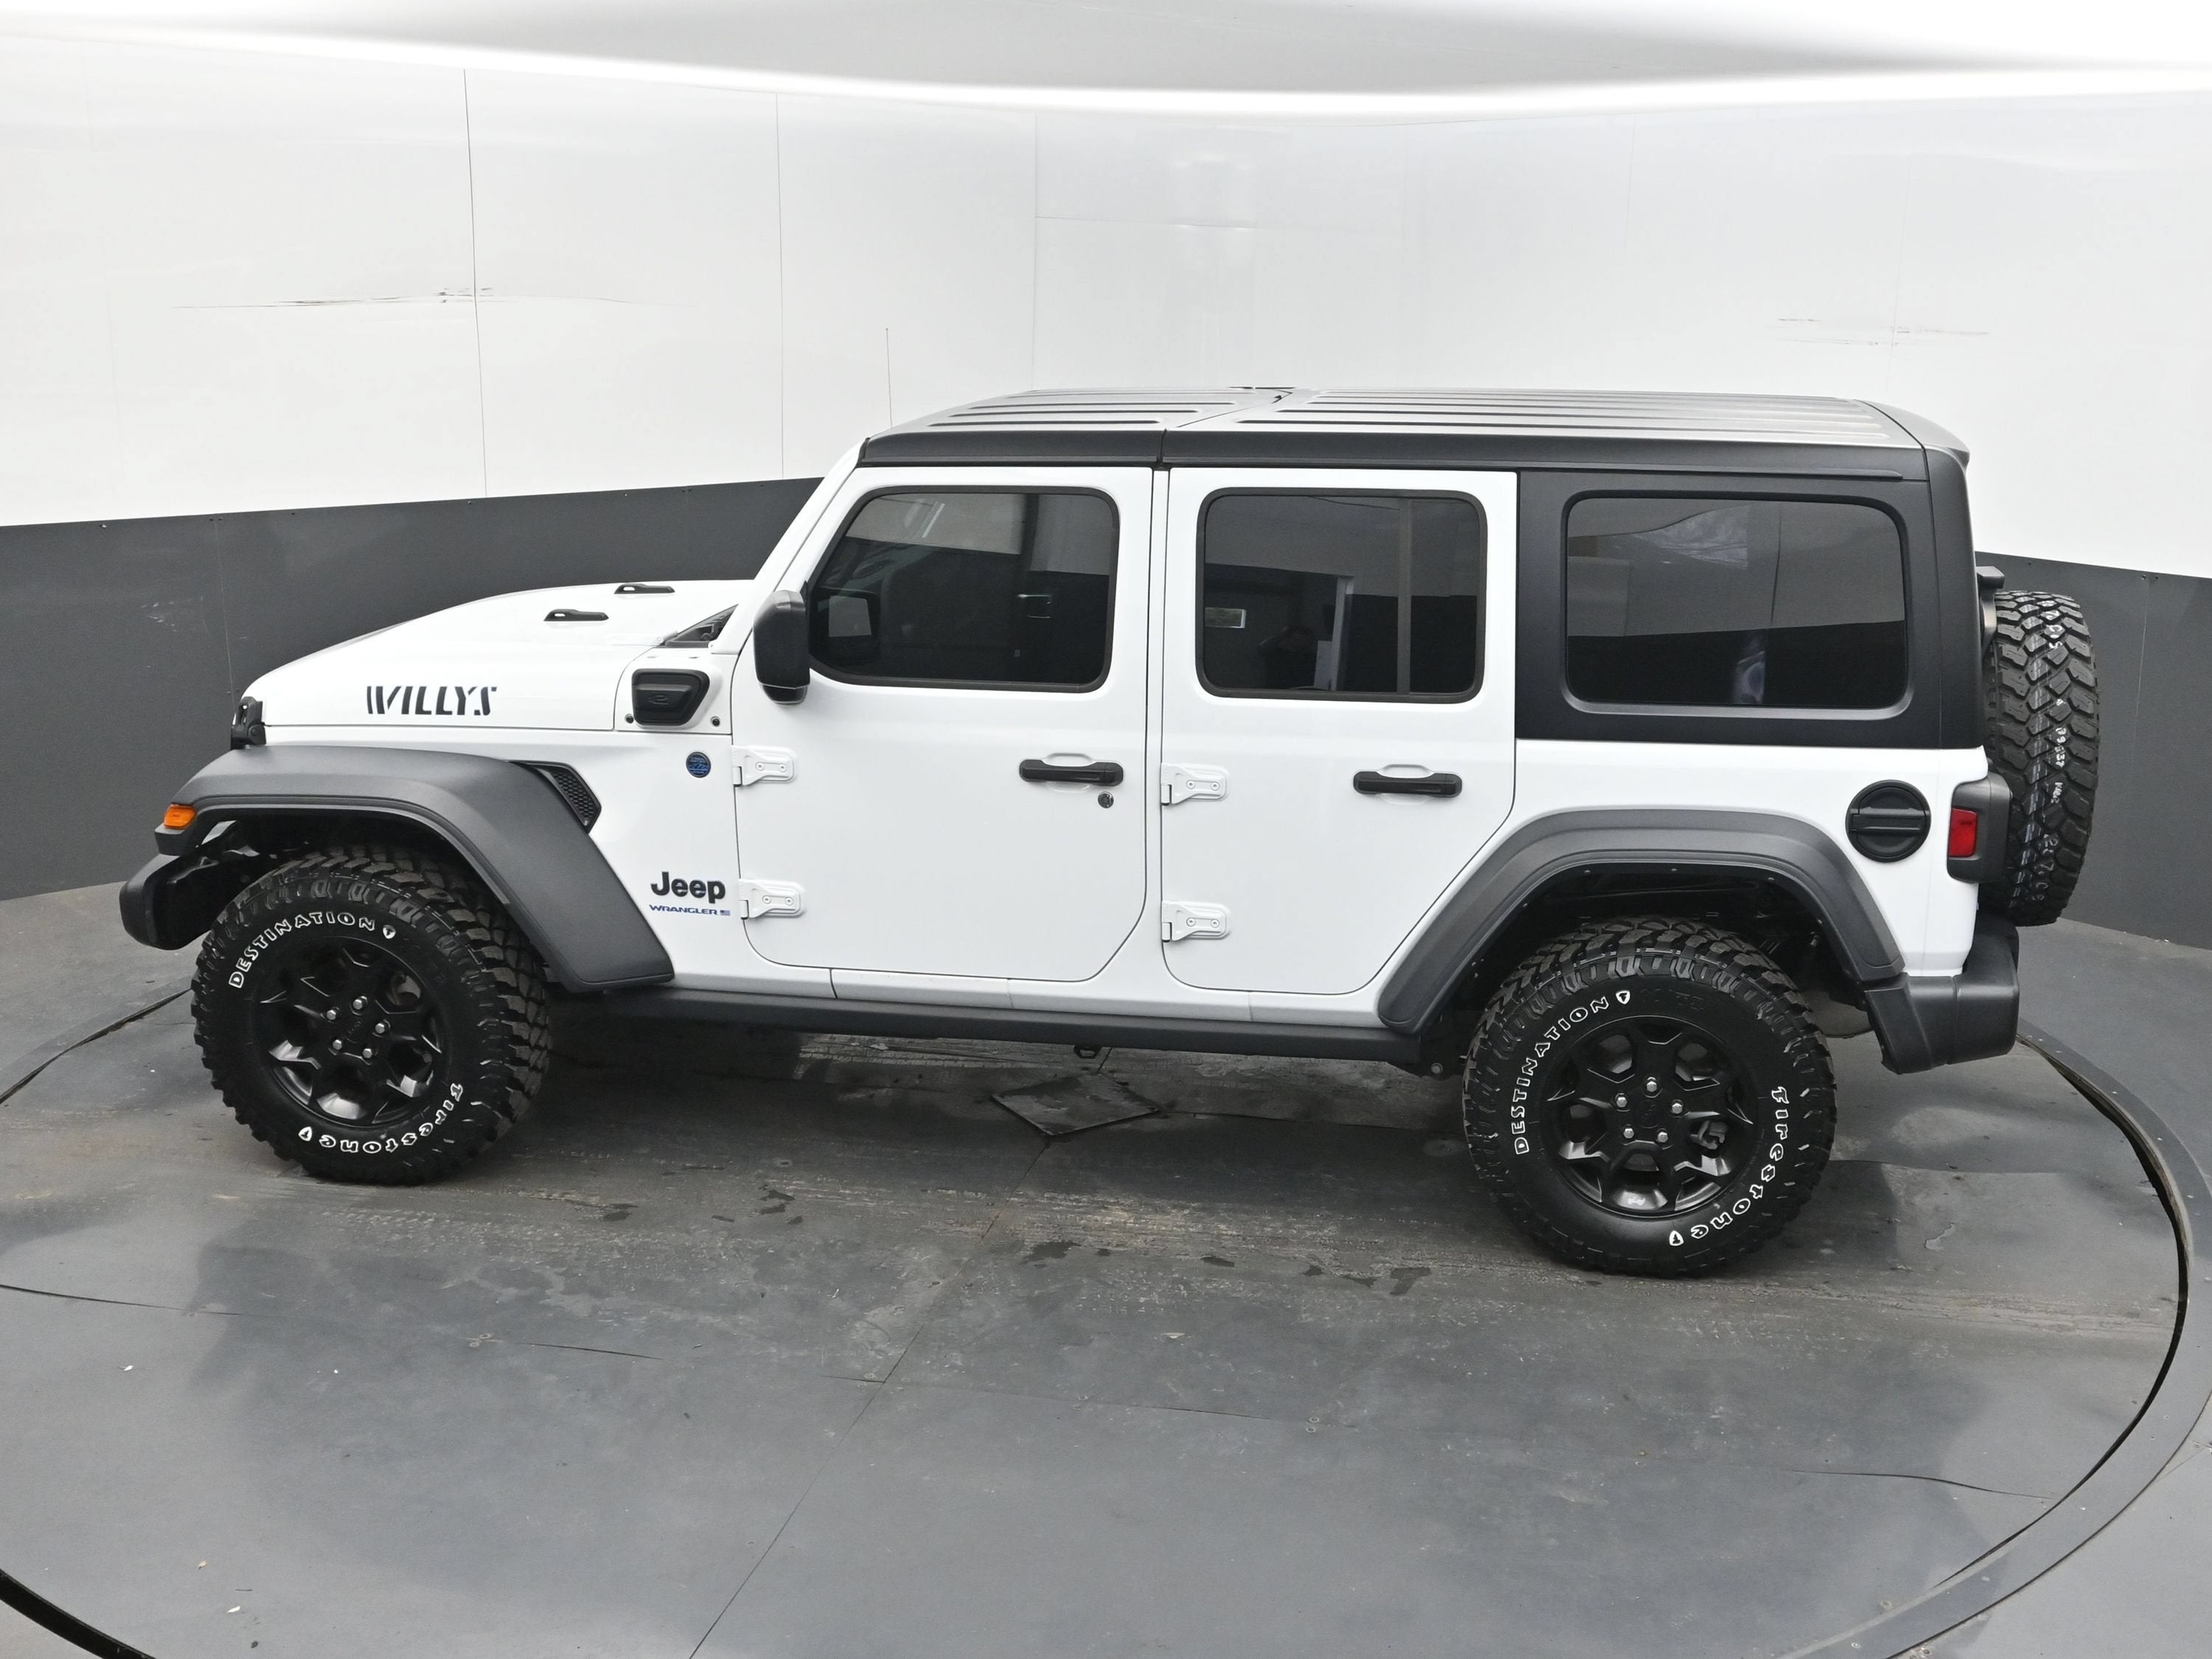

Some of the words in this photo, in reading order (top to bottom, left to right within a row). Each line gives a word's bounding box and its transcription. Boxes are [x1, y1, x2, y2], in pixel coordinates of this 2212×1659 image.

[366, 686, 497, 716] WILLYS
[650, 871, 726, 904] Jeep
[649, 904, 718, 915] WRANGLER
[229, 911, 375, 989] DESTINATION
[1511, 997, 1609, 1155] DESTINATION
